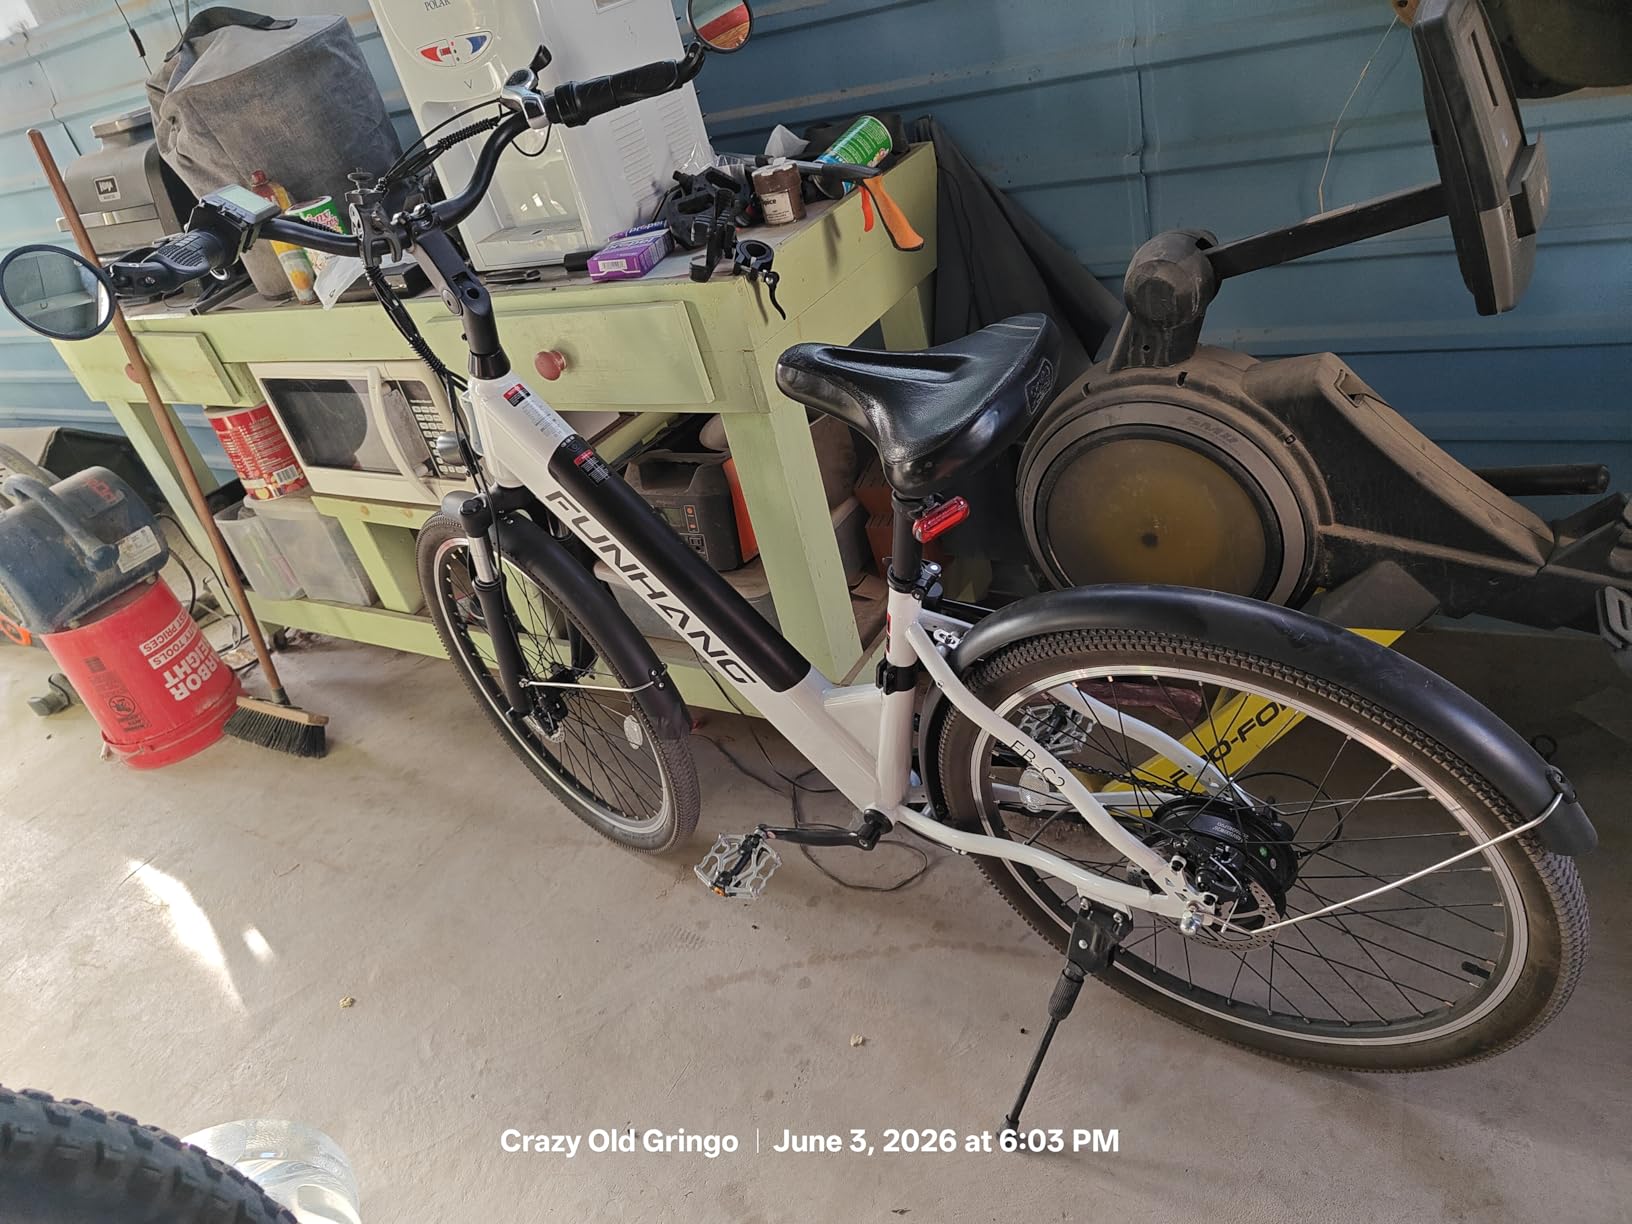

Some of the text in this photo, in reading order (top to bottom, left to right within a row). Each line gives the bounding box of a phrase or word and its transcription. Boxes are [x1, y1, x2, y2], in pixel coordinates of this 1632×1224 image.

[545, 490, 757, 684] FUNHANG
[143, 625, 178, 653] PRICES
[153, 638, 185, 666] TOOLS
[163, 637, 210, 689] EIGHT
